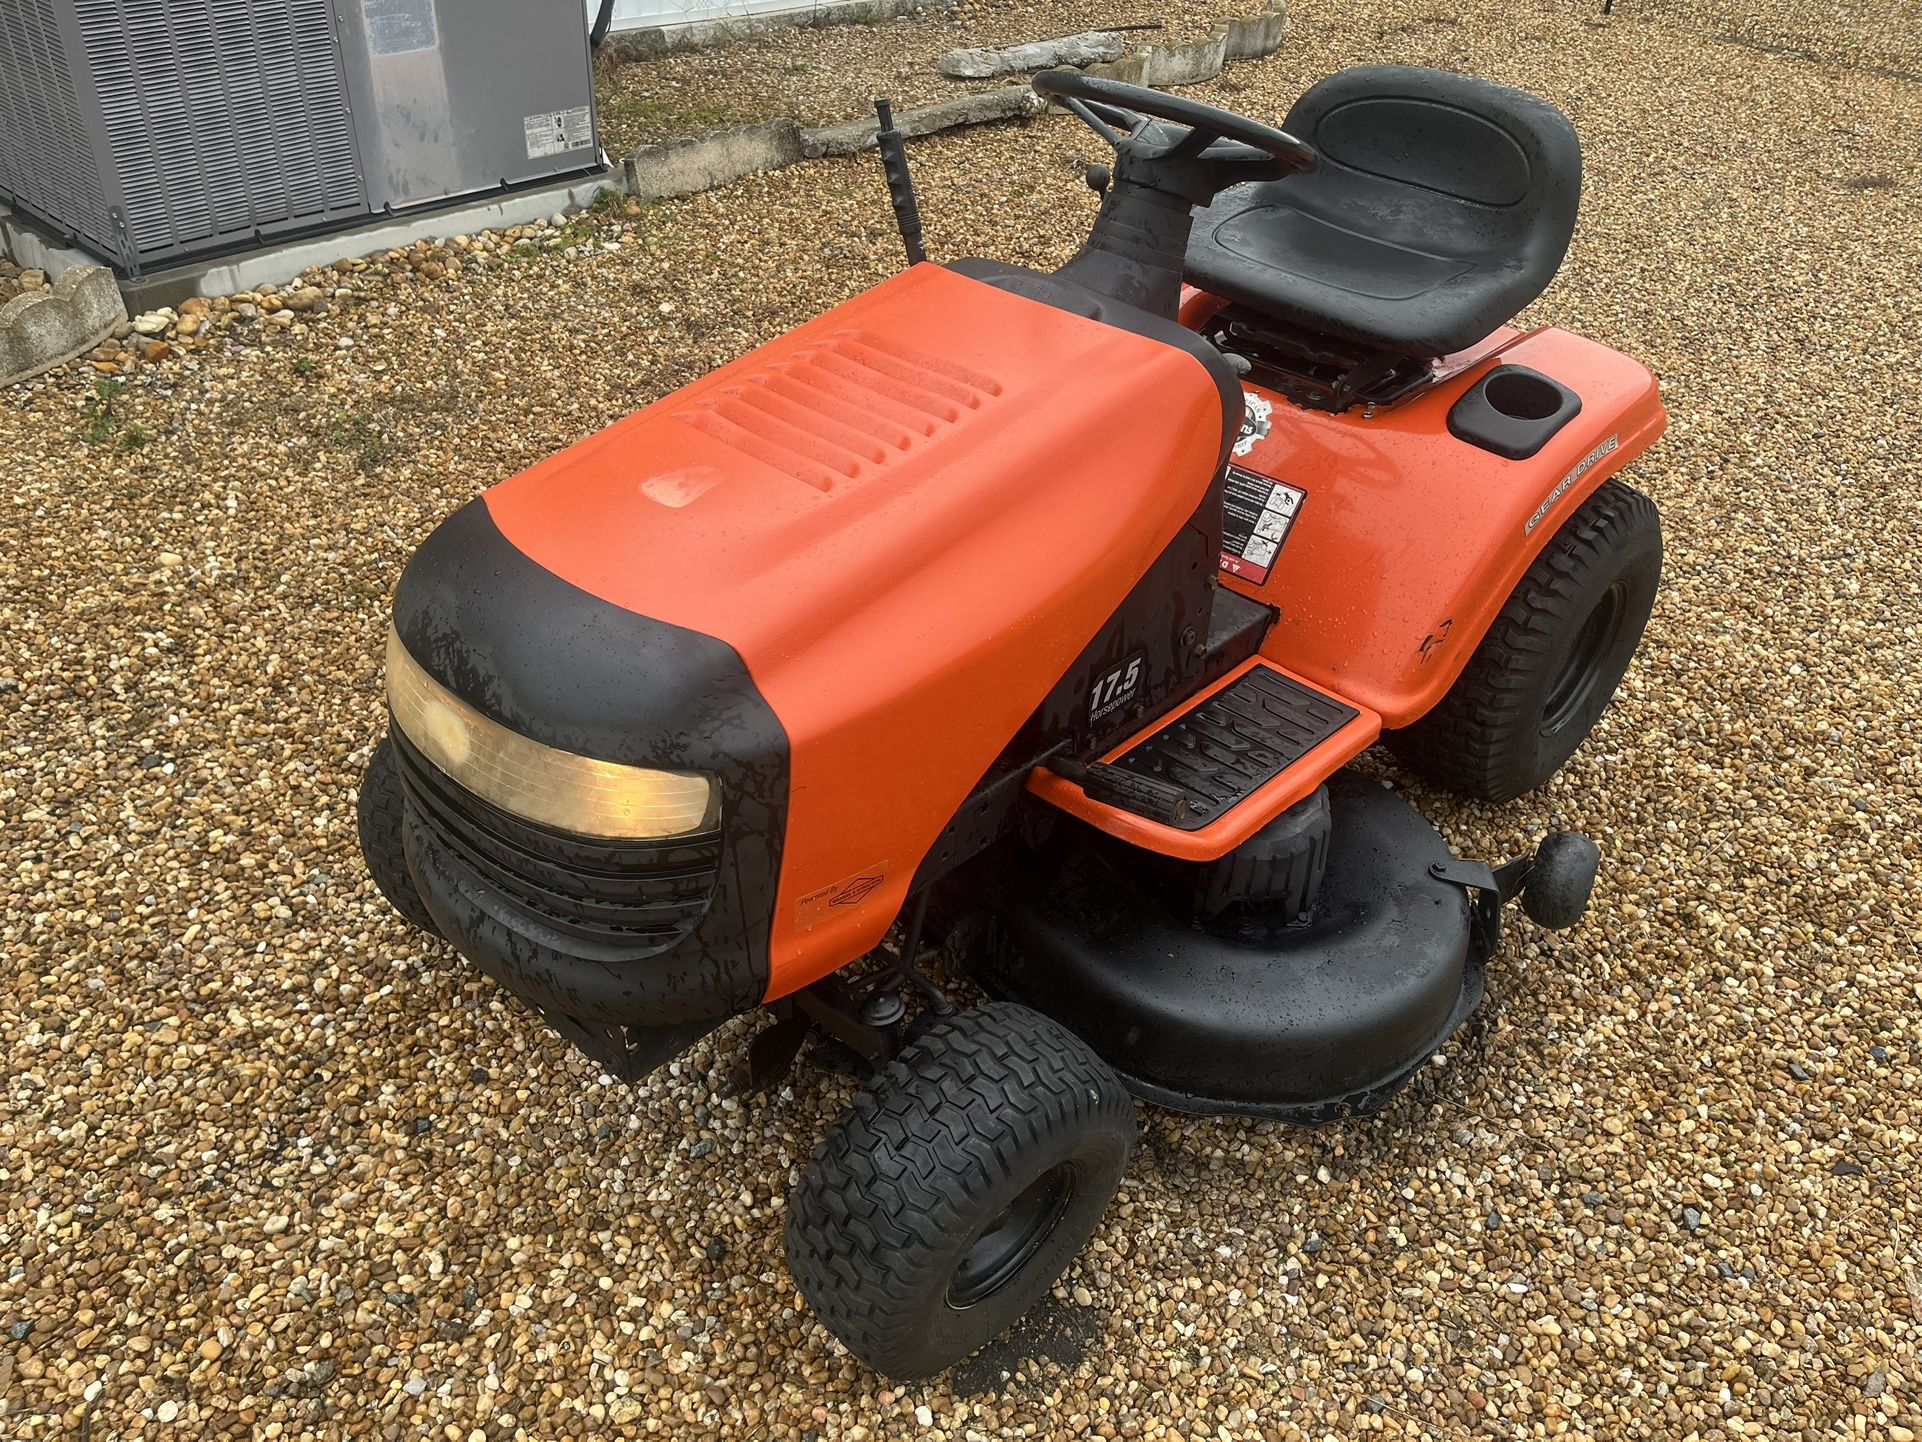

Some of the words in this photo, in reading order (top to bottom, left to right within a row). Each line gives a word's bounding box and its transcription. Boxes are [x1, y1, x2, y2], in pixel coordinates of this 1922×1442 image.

[1527, 474, 1572, 529] GEAR
[1576, 436, 1617, 477] DRIVE
[1091, 657, 1142, 711] 17.5
[1091, 688, 1136, 722] Horsepower
